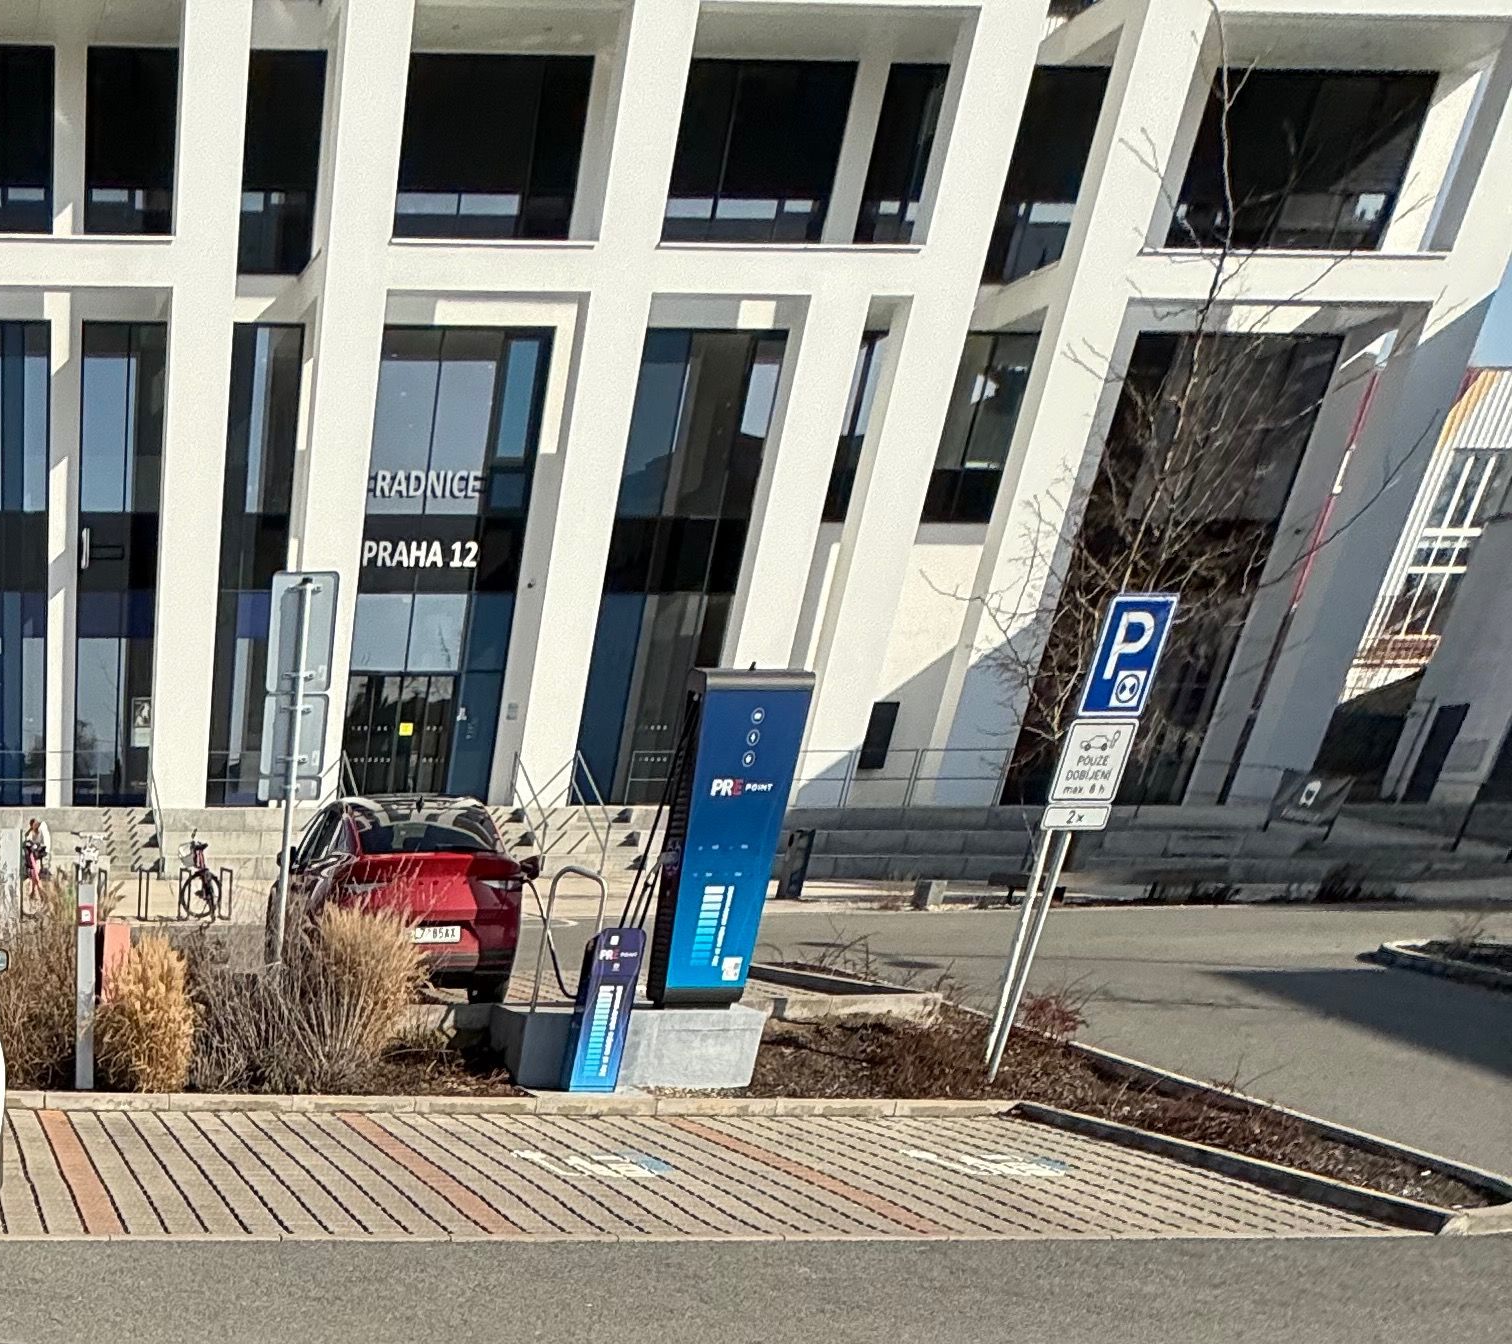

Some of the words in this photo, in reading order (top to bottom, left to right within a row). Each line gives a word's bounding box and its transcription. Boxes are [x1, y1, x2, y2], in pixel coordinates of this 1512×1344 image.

[375, 470, 482, 497] RADNICE
[362, 540, 444, 567] PRAHA
[449, 540, 479, 567] 12
[1102, 611, 1155, 680] P
[1077, 755, 1110, 766] POUZE
[710, 778, 744, 797] PRE
[744, 783, 774, 792] POINT
